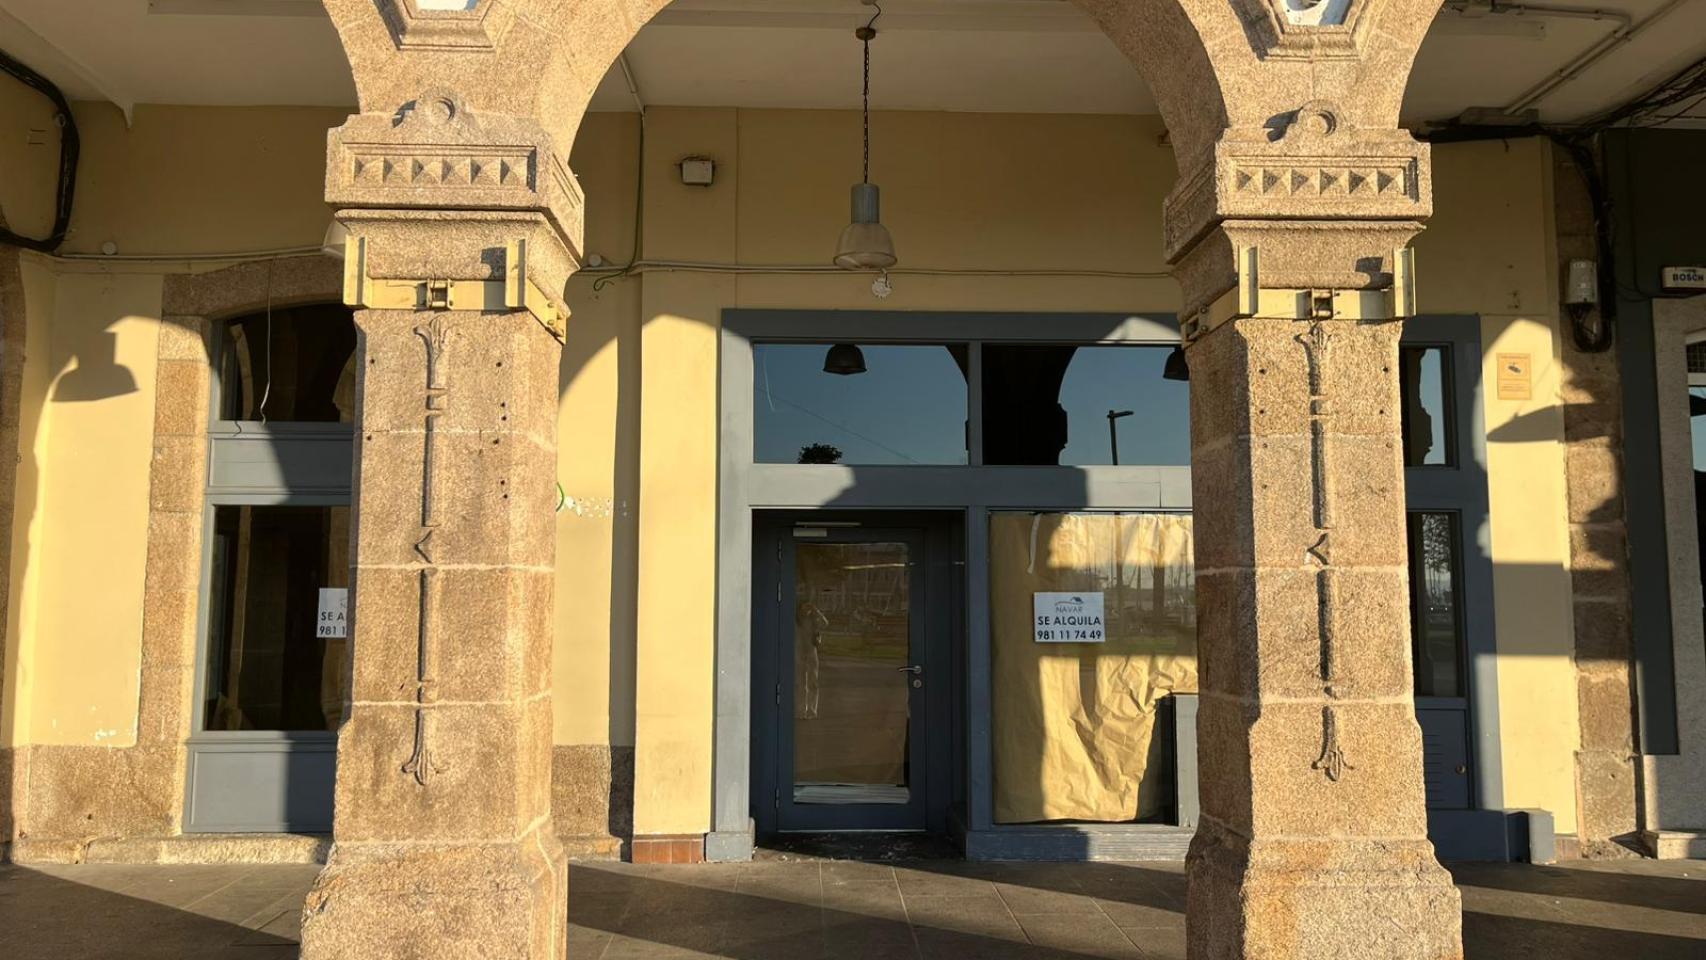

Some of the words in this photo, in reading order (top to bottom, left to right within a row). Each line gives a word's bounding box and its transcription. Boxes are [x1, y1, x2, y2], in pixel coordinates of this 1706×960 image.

[1673, 273, 1704, 282] BOSCH
[321, 611, 333, 621] SE
[1037, 616, 1050, 626] SE
[1054, 616, 1101, 626] ALQUILA
[320, 626, 336, 636] 981
[1037, 630, 1055, 640] 981
[1059, 630, 1070, 640] 11
[1074, 630, 1086, 640] 74
[1089, 630, 1102, 640] 49
